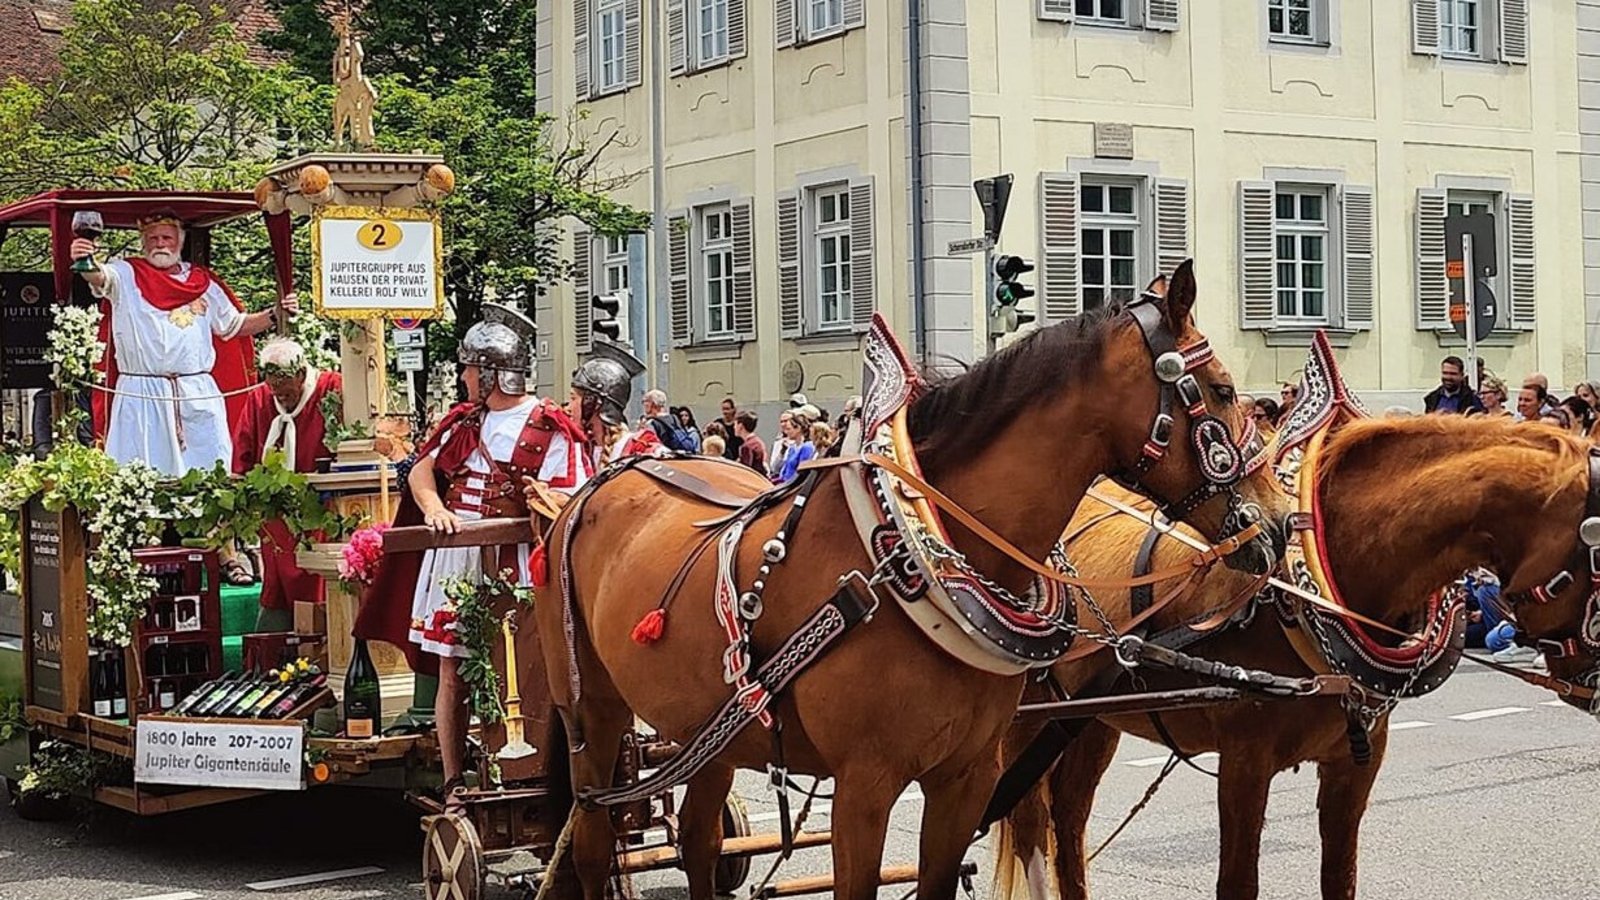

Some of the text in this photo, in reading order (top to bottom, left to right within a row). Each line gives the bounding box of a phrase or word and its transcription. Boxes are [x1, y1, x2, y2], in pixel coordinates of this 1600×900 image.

[371, 224, 386, 246] 2
[330, 262, 426, 274] JUPITERGRUPPE AUS
[330, 274, 428, 286] HAUSEN DER PRIVAT-
[330, 286, 428, 298] KELLEREI ROLF WILLY
[4, 306, 53, 318] JUPITE
[181, 731, 217, 747] Jahre
[228, 734, 294, 750] 207-2007
[145, 751, 291, 774] Jupiter Gigantensäule
